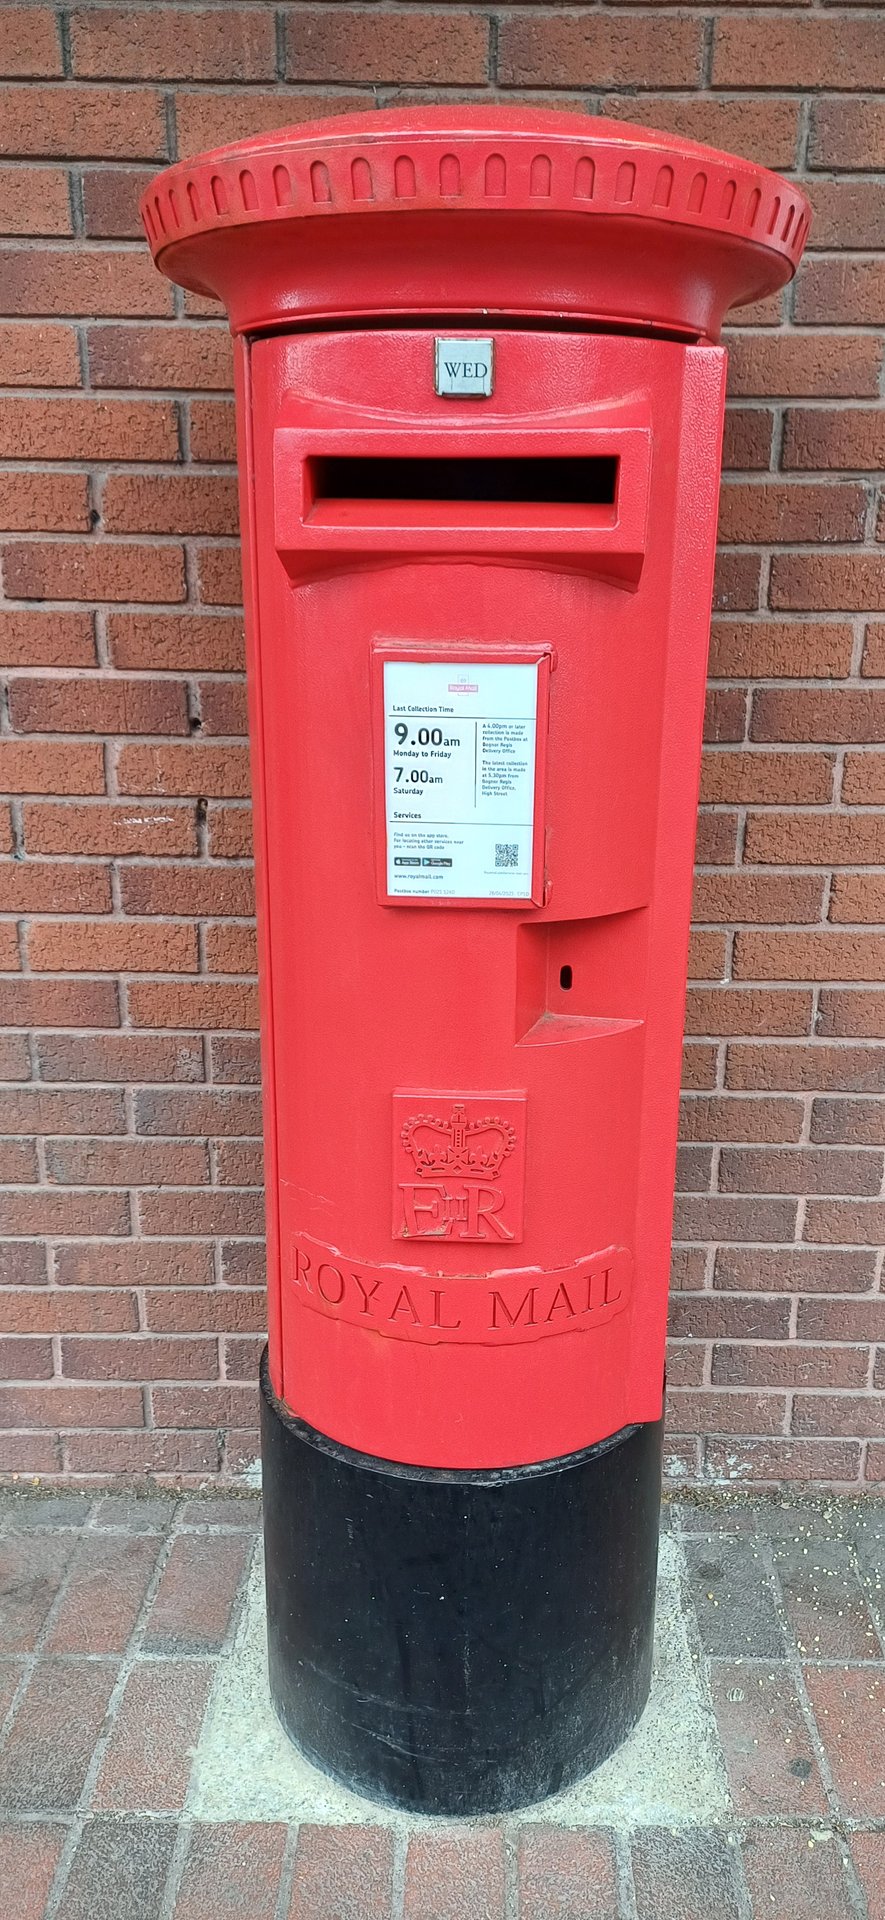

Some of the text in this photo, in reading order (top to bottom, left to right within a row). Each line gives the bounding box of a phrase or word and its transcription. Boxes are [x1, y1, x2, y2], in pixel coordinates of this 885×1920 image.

[444, 362, 488, 378] WED
[394, 722, 460, 746] 9.00am
[394, 767, 443, 783] 7.00am
[292, 1246, 622, 1331] ROYAL MAIL
